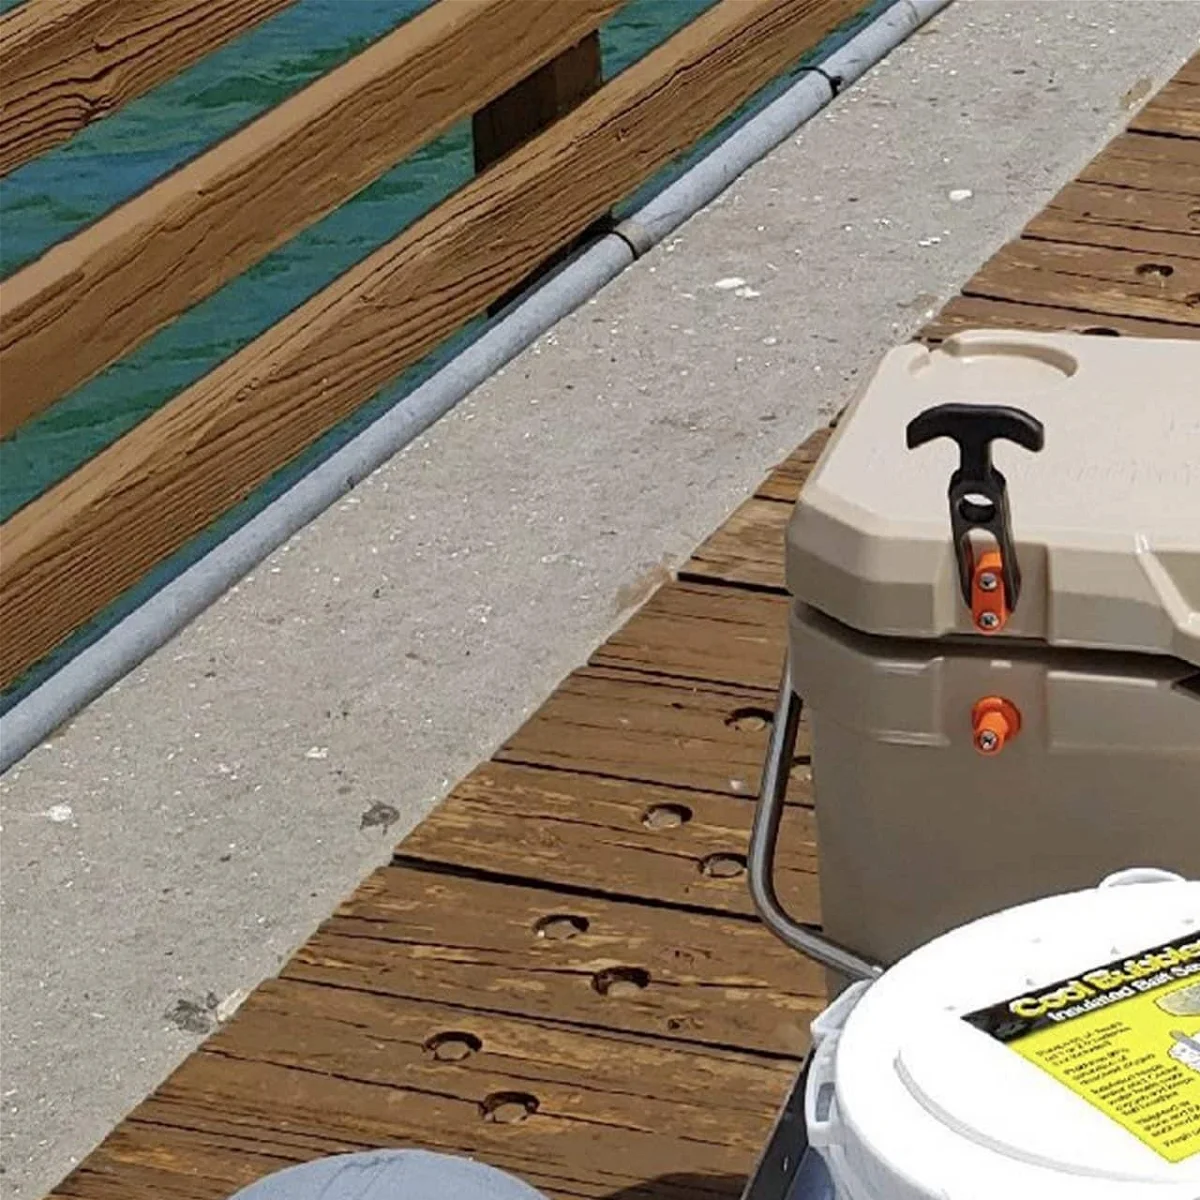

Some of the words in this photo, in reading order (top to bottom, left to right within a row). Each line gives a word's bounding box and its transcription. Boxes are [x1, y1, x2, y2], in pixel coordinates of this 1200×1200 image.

[1008, 978, 1098, 1018] Cool
[1047, 986, 1136, 1022] Insulated
[1132, 971, 1171, 992] Bait
